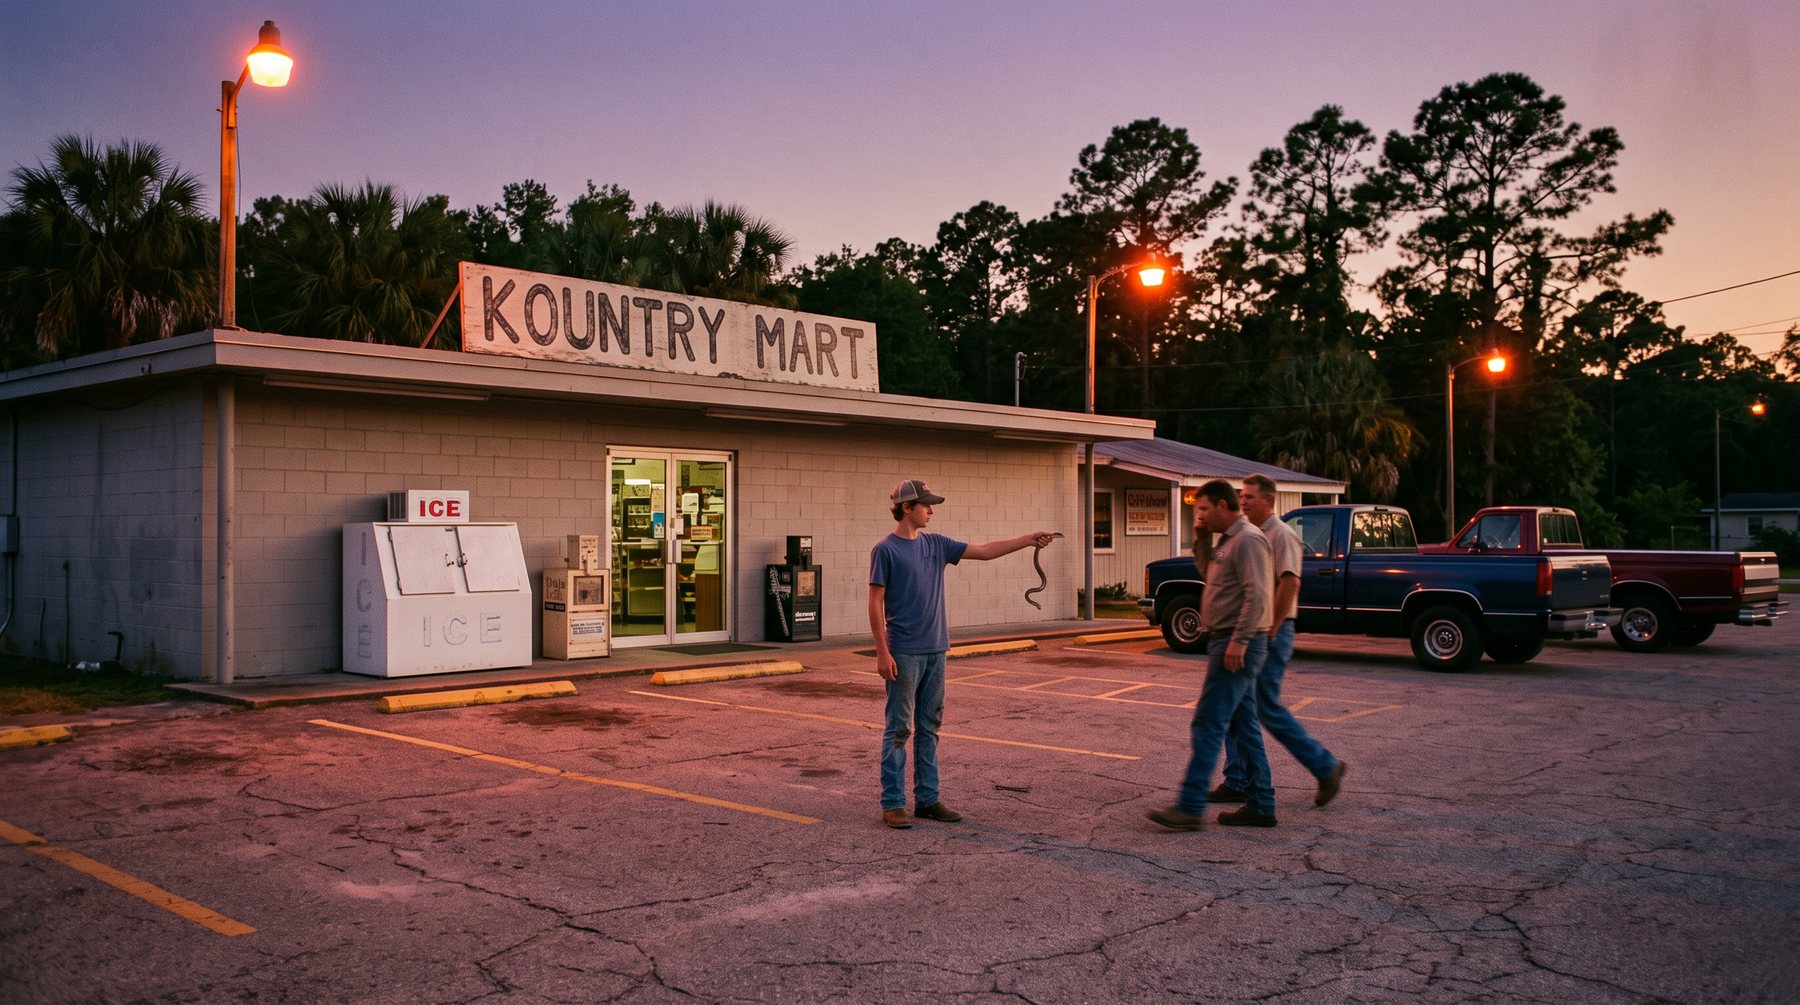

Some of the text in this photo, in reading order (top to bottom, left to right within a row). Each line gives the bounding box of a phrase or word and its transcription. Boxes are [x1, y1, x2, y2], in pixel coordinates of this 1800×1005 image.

[482, 275, 864, 379] KOUNTRY MART
[419, 500, 461, 517] ICE
[422, 614, 502, 647] ICE
